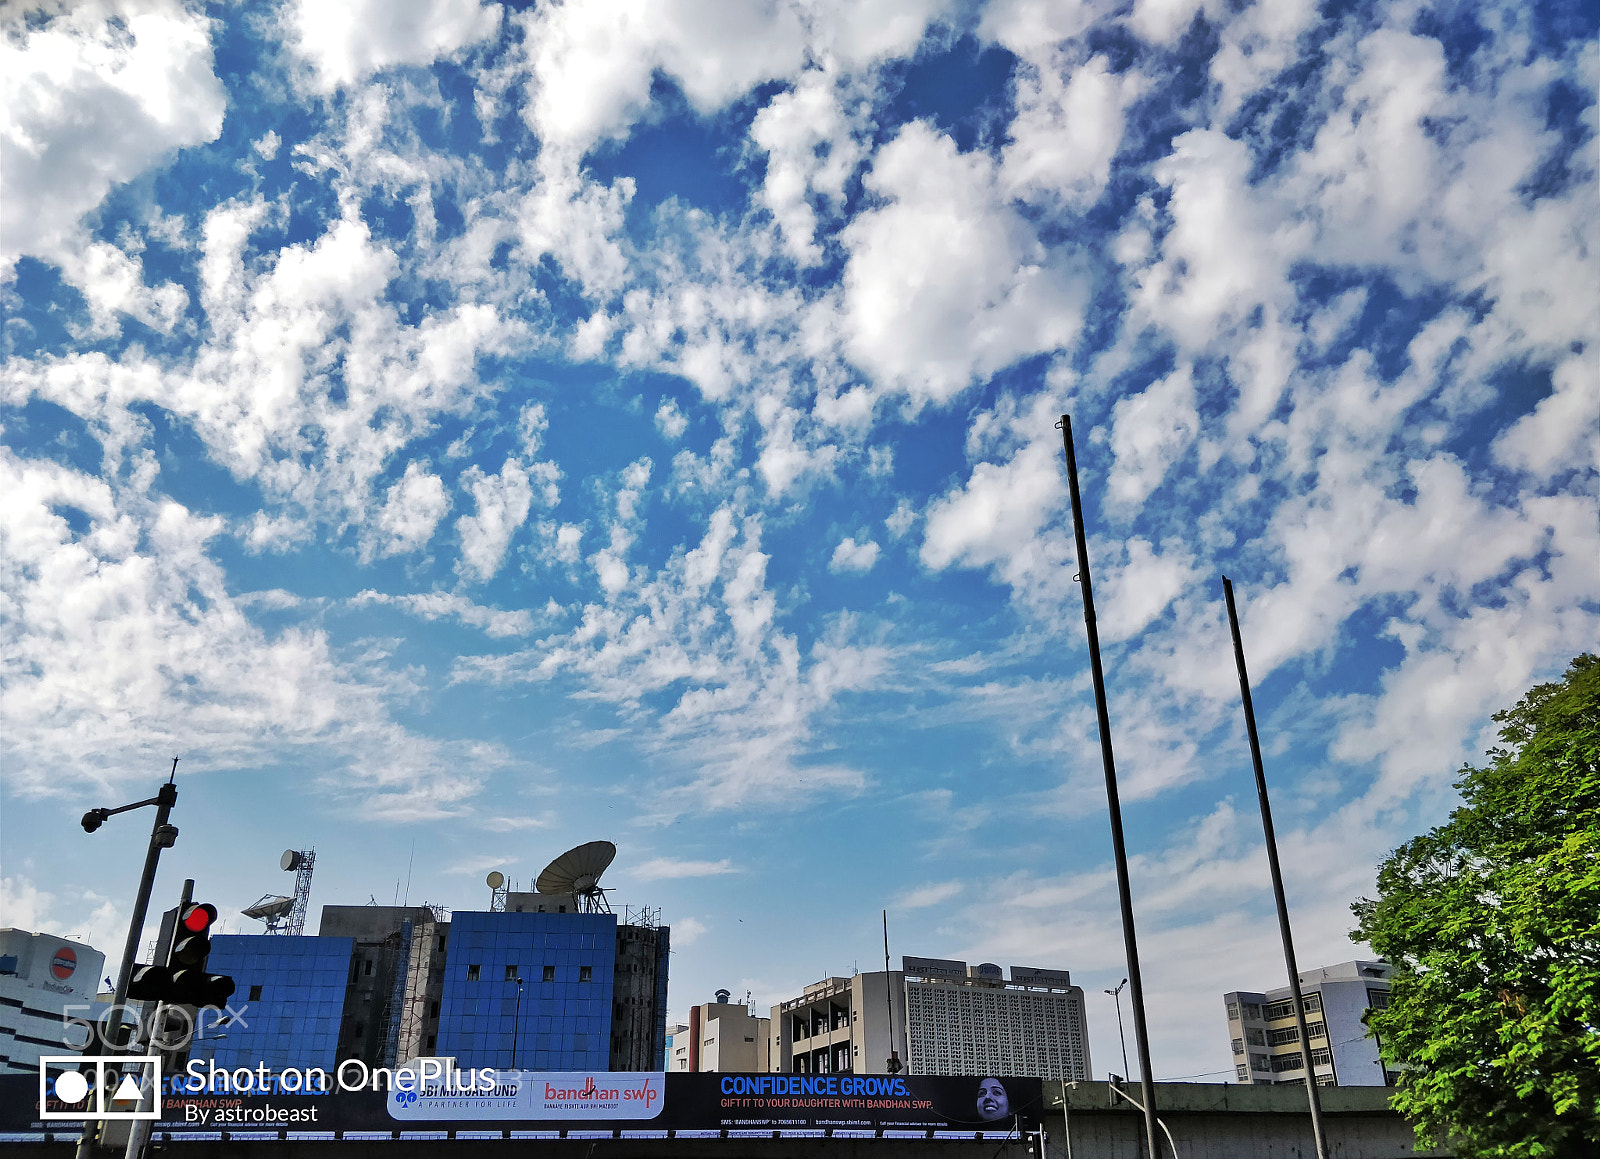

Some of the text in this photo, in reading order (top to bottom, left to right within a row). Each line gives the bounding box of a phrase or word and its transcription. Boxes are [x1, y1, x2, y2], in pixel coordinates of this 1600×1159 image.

[545, 1077, 657, 1109] bandhan swp
[720, 1076, 910, 1096] CONFIDENCE GROWS.
[720, 1098, 934, 1110] GIFT IT TO YOUR DAUGHTER WITH BANDHAN SWP.
